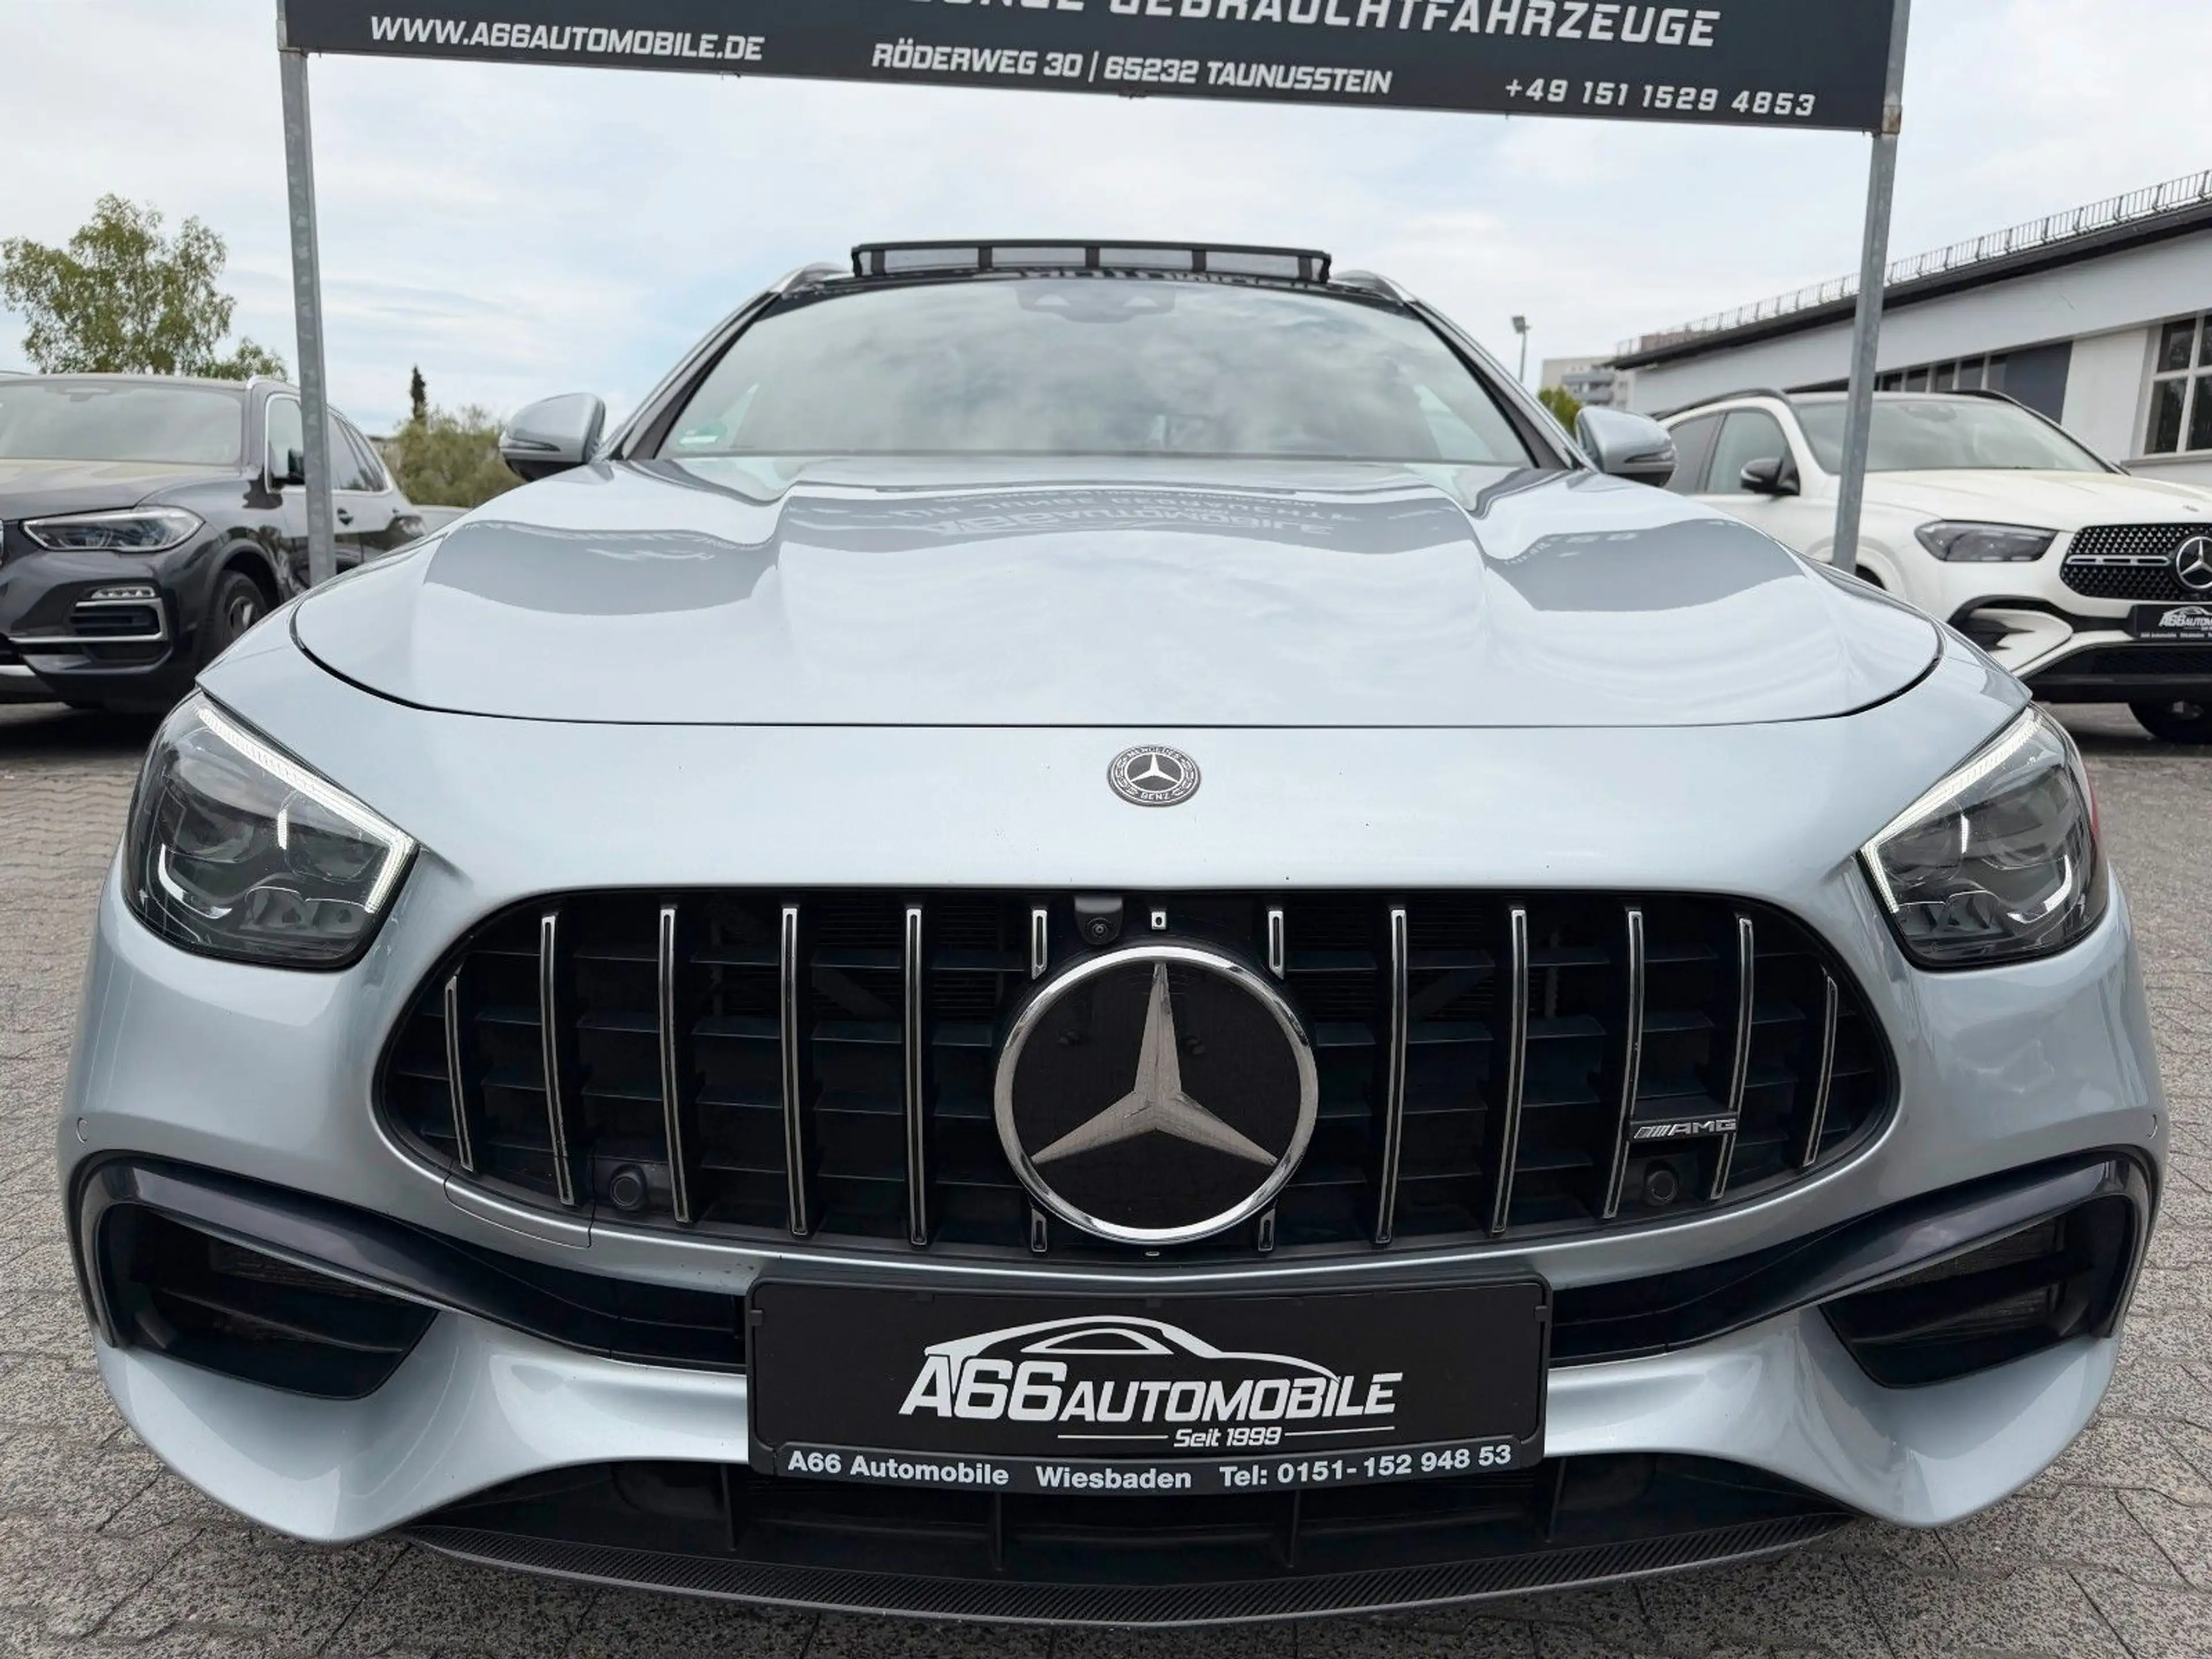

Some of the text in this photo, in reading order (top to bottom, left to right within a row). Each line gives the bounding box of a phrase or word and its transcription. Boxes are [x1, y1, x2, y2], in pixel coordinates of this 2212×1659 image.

[370, 16, 766, 60] WWW.A66AUTOMOBILE.DE
[872, 37, 1039, 75] RÖDERWEG
[1043, 52, 1084, 77] 30
[1104, 56, 1199, 84] 65232
[1205, 61, 1393, 93] TAUNUSSTEIN
[1505, 78, 1816, 116] +49 151 1529 4853
[1668, 1118, 1736, 1136] AMG
[1173, 1426, 1283, 1447] Seit 1999
[788, 1450, 842, 1474] A66
[850, 1455, 1009, 1485] Automobile
[1036, 1466, 1192, 1489] Wiesbaden
[1219, 1465, 1267, 1486] Tel:
[1421, 1449, 1470, 1472] 948
[1478, 1444, 1511, 1466] 53
